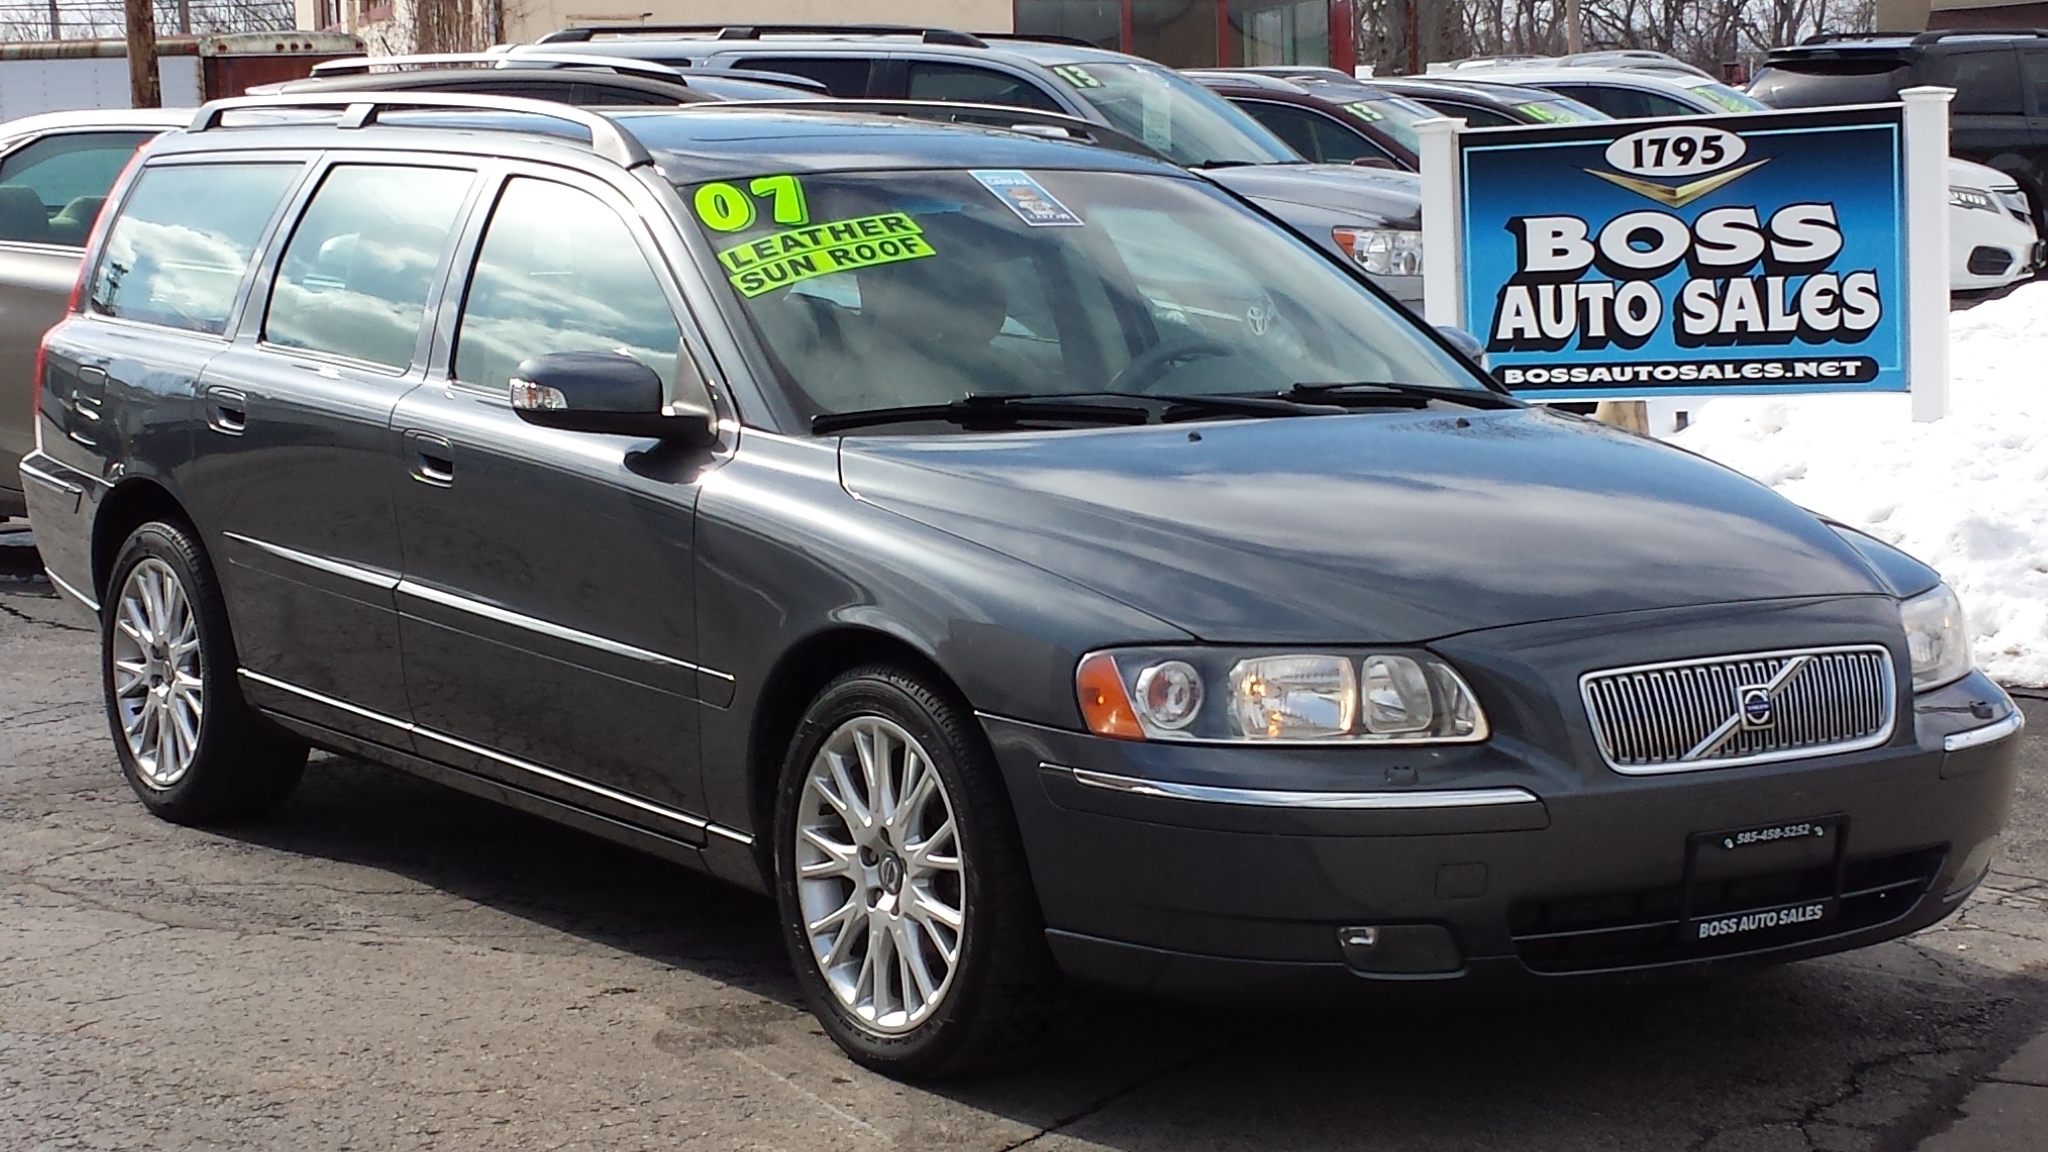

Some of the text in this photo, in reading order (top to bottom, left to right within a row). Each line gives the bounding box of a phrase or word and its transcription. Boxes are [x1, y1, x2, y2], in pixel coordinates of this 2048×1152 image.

[1053, 65, 1102, 88] 13
[1343, 102, 1383, 121] 13
[1631, 134, 1726, 170] 1795
[694, 174, 810, 232] 07
[727, 215, 912, 270] LEATHER
[1514, 202, 1845, 276] BOSS
[740, 237, 919, 292] SUN ROOF
[1494, 270, 1882, 341] AUTO SALES
[1503, 359, 1864, 386] BOSSAUTOSALES.NET
[1736, 823, 1811, 845] 585-458-5252
[1699, 904, 1824, 938] BOSS AUTO SALES
